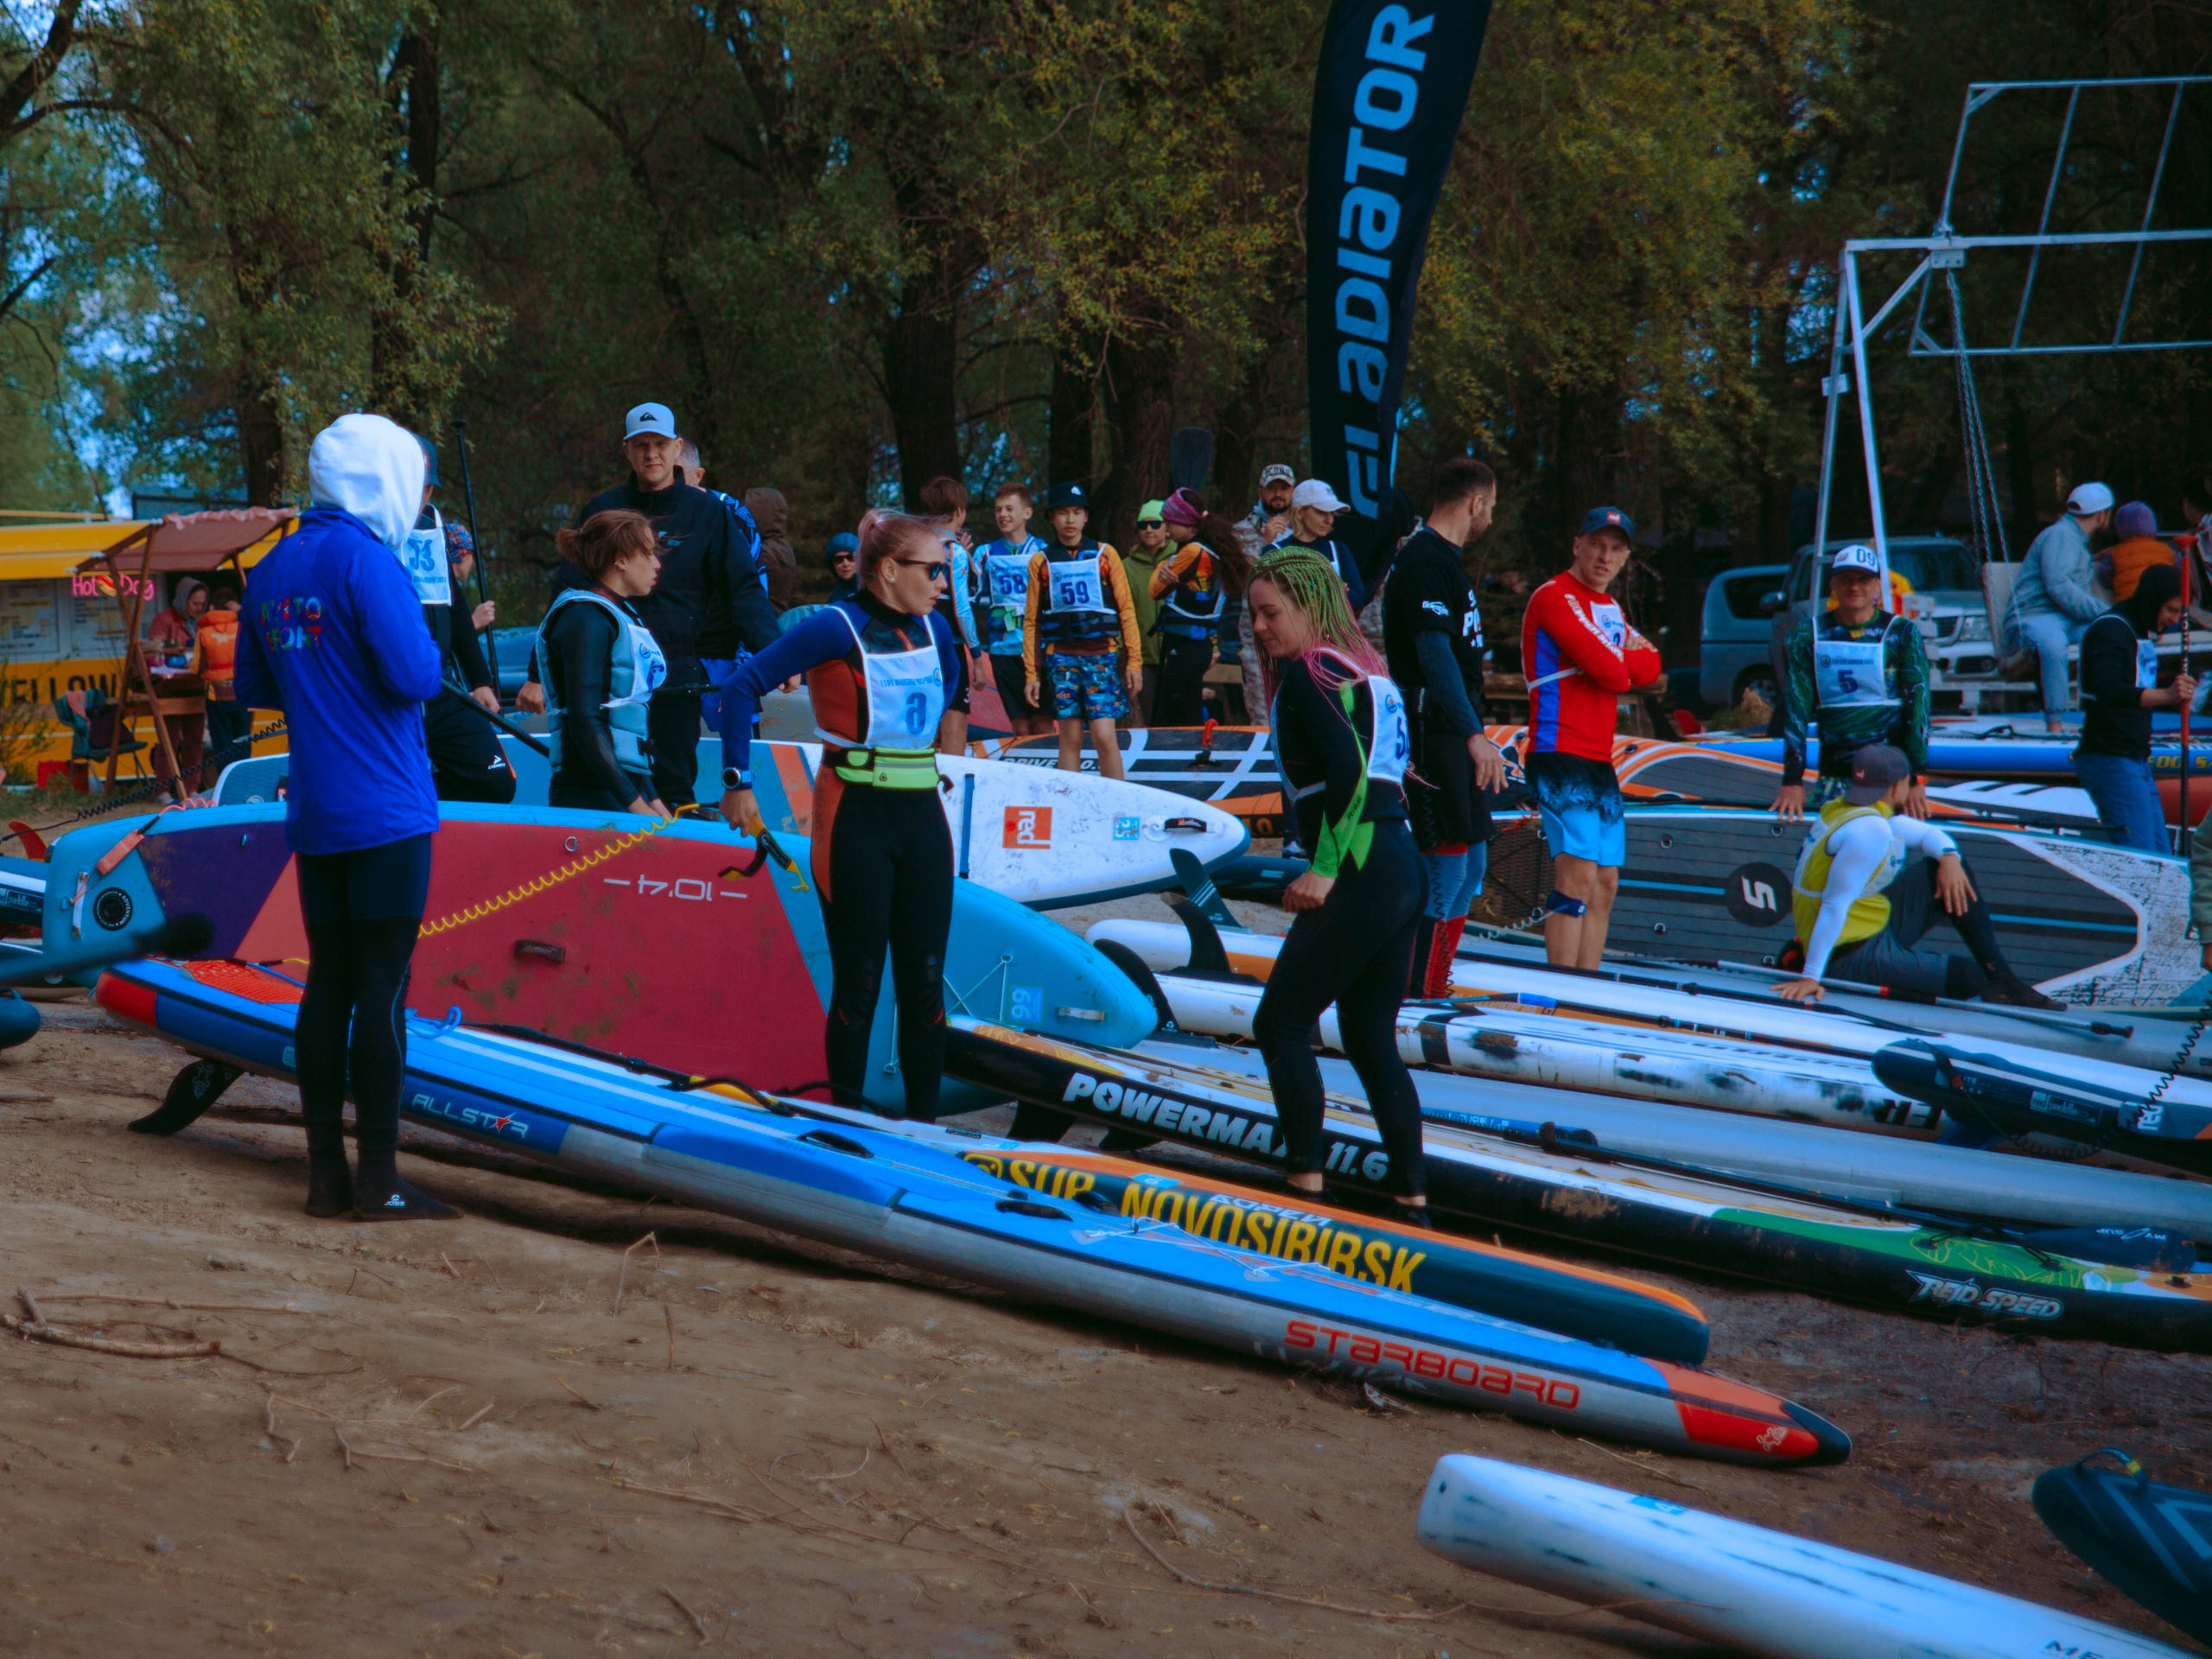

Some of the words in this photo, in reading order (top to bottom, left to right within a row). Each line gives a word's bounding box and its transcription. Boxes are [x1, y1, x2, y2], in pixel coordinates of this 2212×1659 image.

[1856, 548, 1876, 566] 09
[72, 575, 99, 597] Hot
[119, 573, 155, 601] Dog
[998, 573, 1027, 595] 58
[1059, 580, 1090, 606] 59
[1837, 670, 1858, 693] 5
[1017, 810, 1052, 844] red
[1325, 1141, 1389, 1181] 11.6
[1978, 1288, 2063, 1319] SPEED
